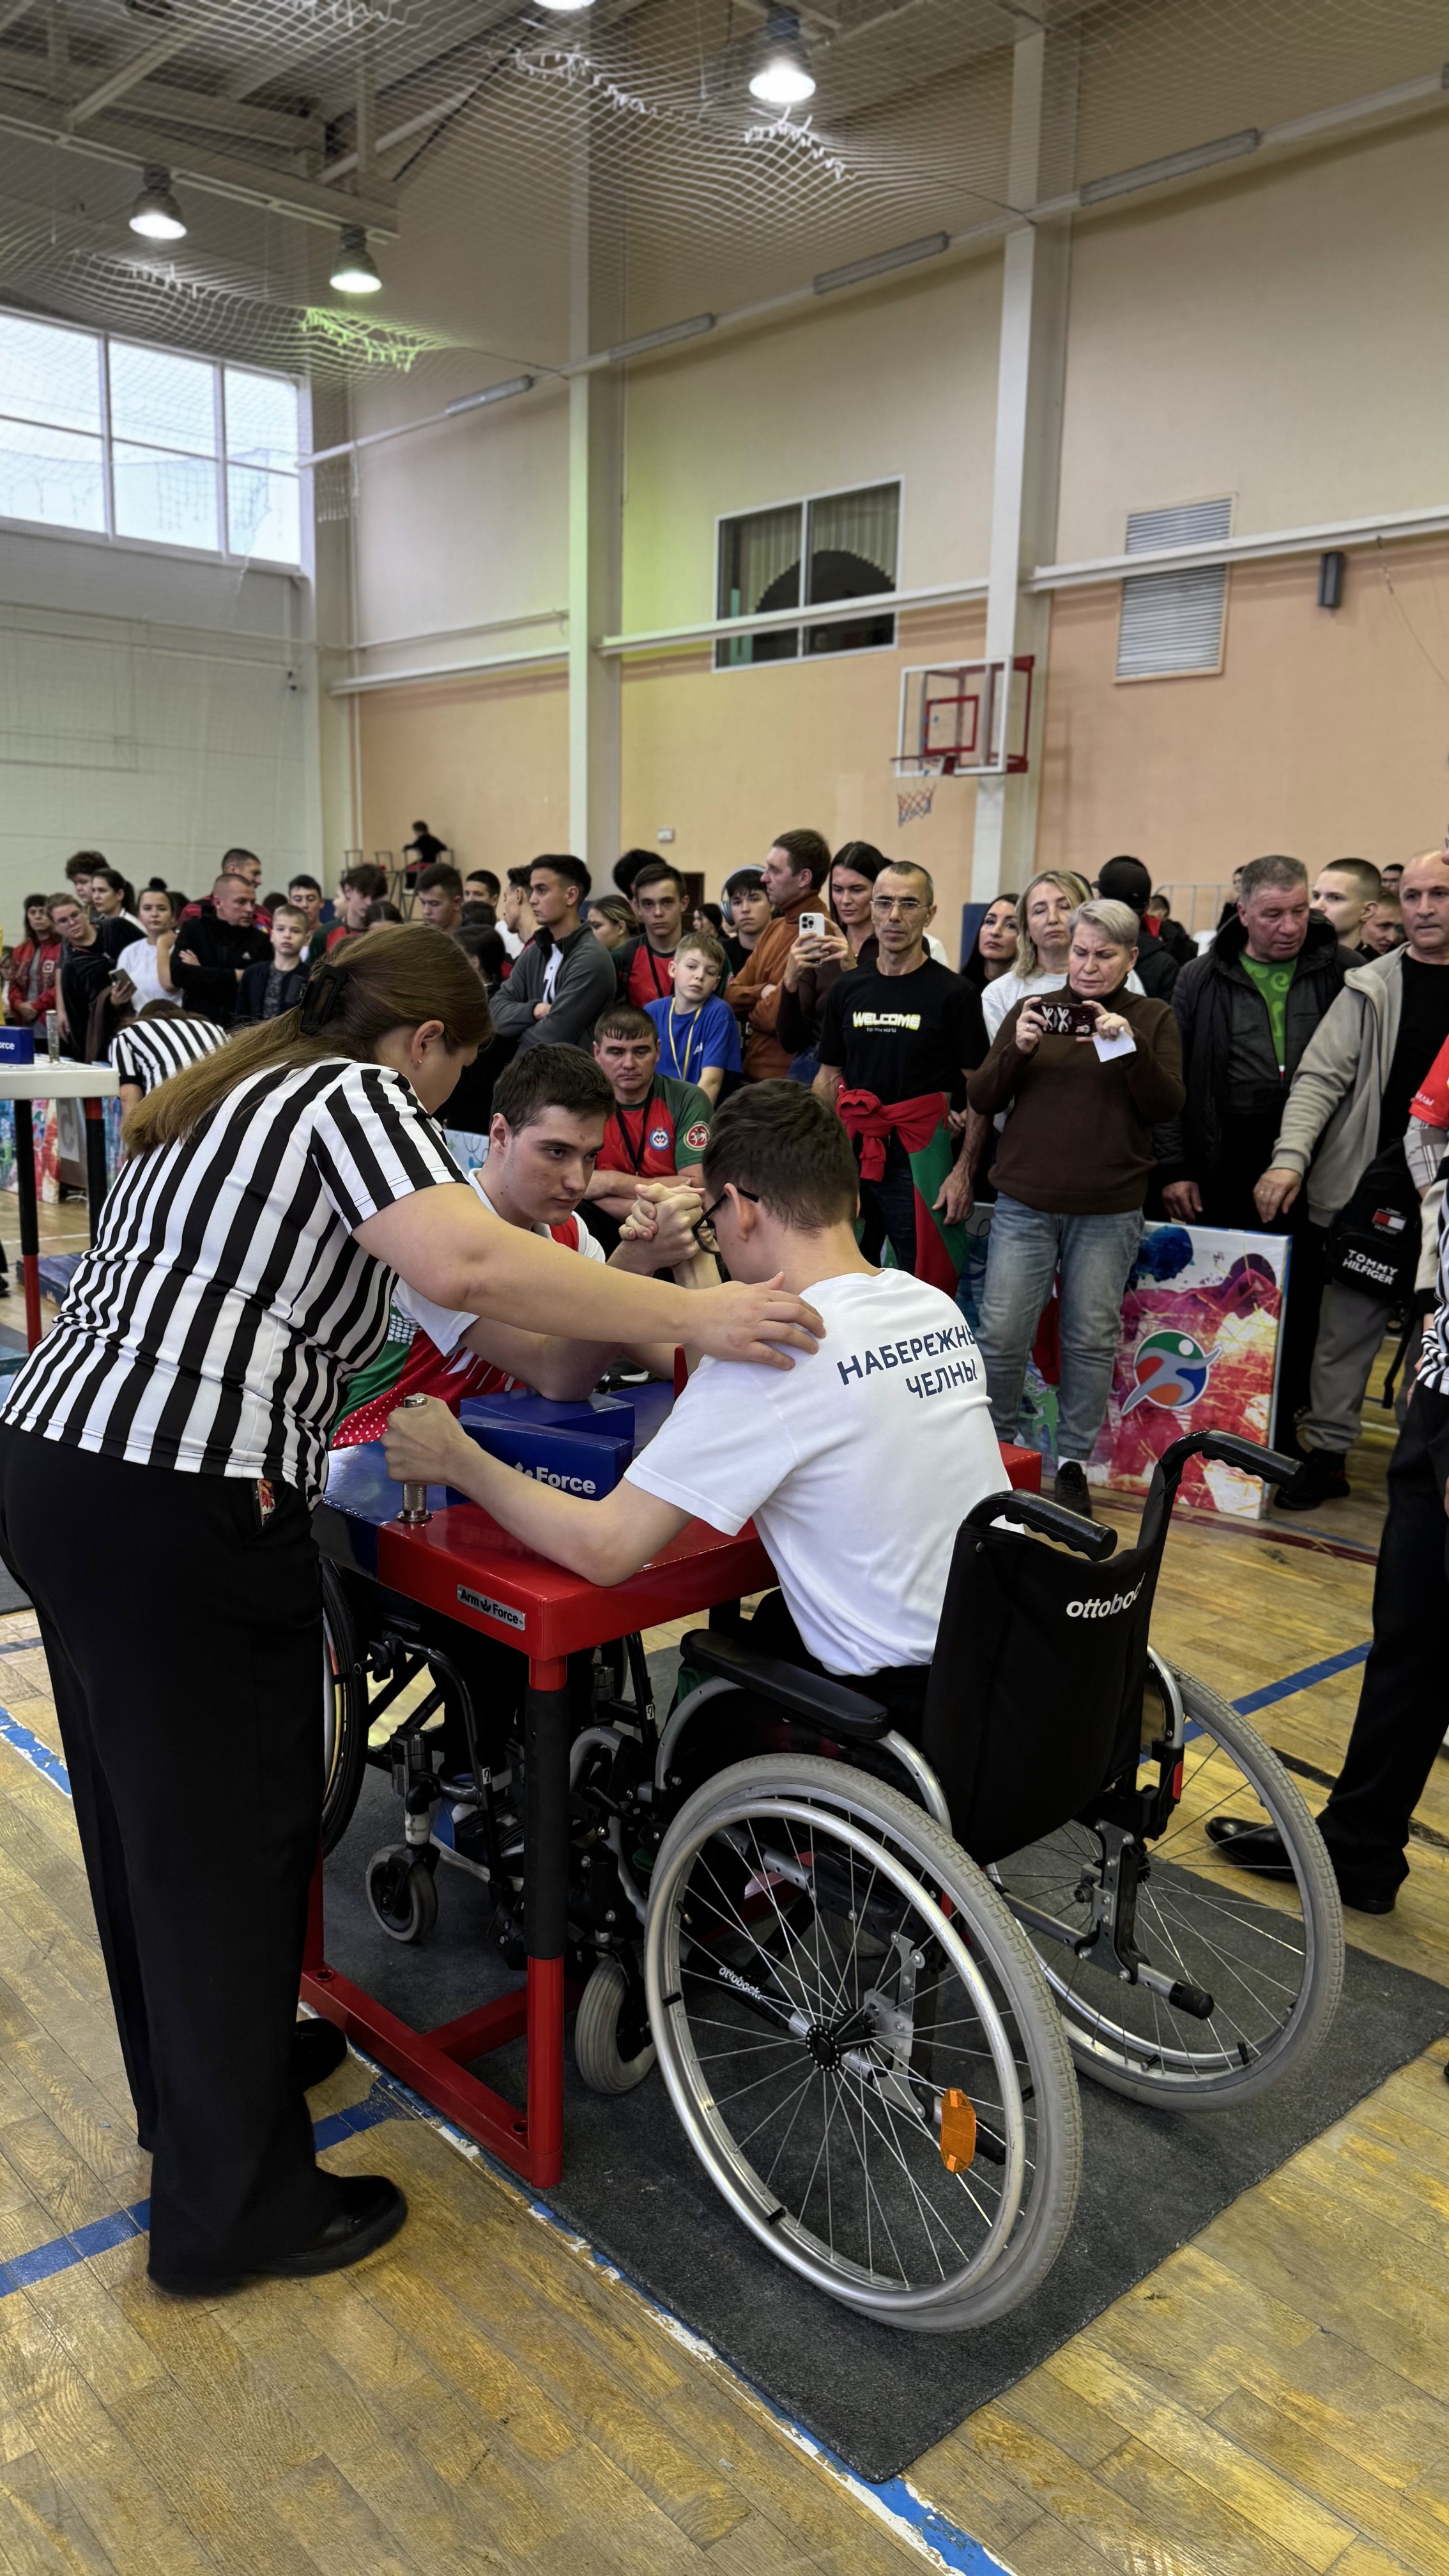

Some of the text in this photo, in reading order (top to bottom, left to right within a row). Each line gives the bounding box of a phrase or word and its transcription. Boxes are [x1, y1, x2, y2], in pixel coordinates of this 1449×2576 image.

[853, 1011, 921, 1030] WELCOME
[1342, 1258, 1394, 1285] HILFIGER
[1348, 1249, 1399, 1276] TOMMY
[906, 1358, 978, 1399] ЧЕЛНЫ
[536, 1466, 596, 1494] Force
[461, 1588, 519, 1624] Arm Force
[1066, 1572, 1146, 1618] ottoboc
